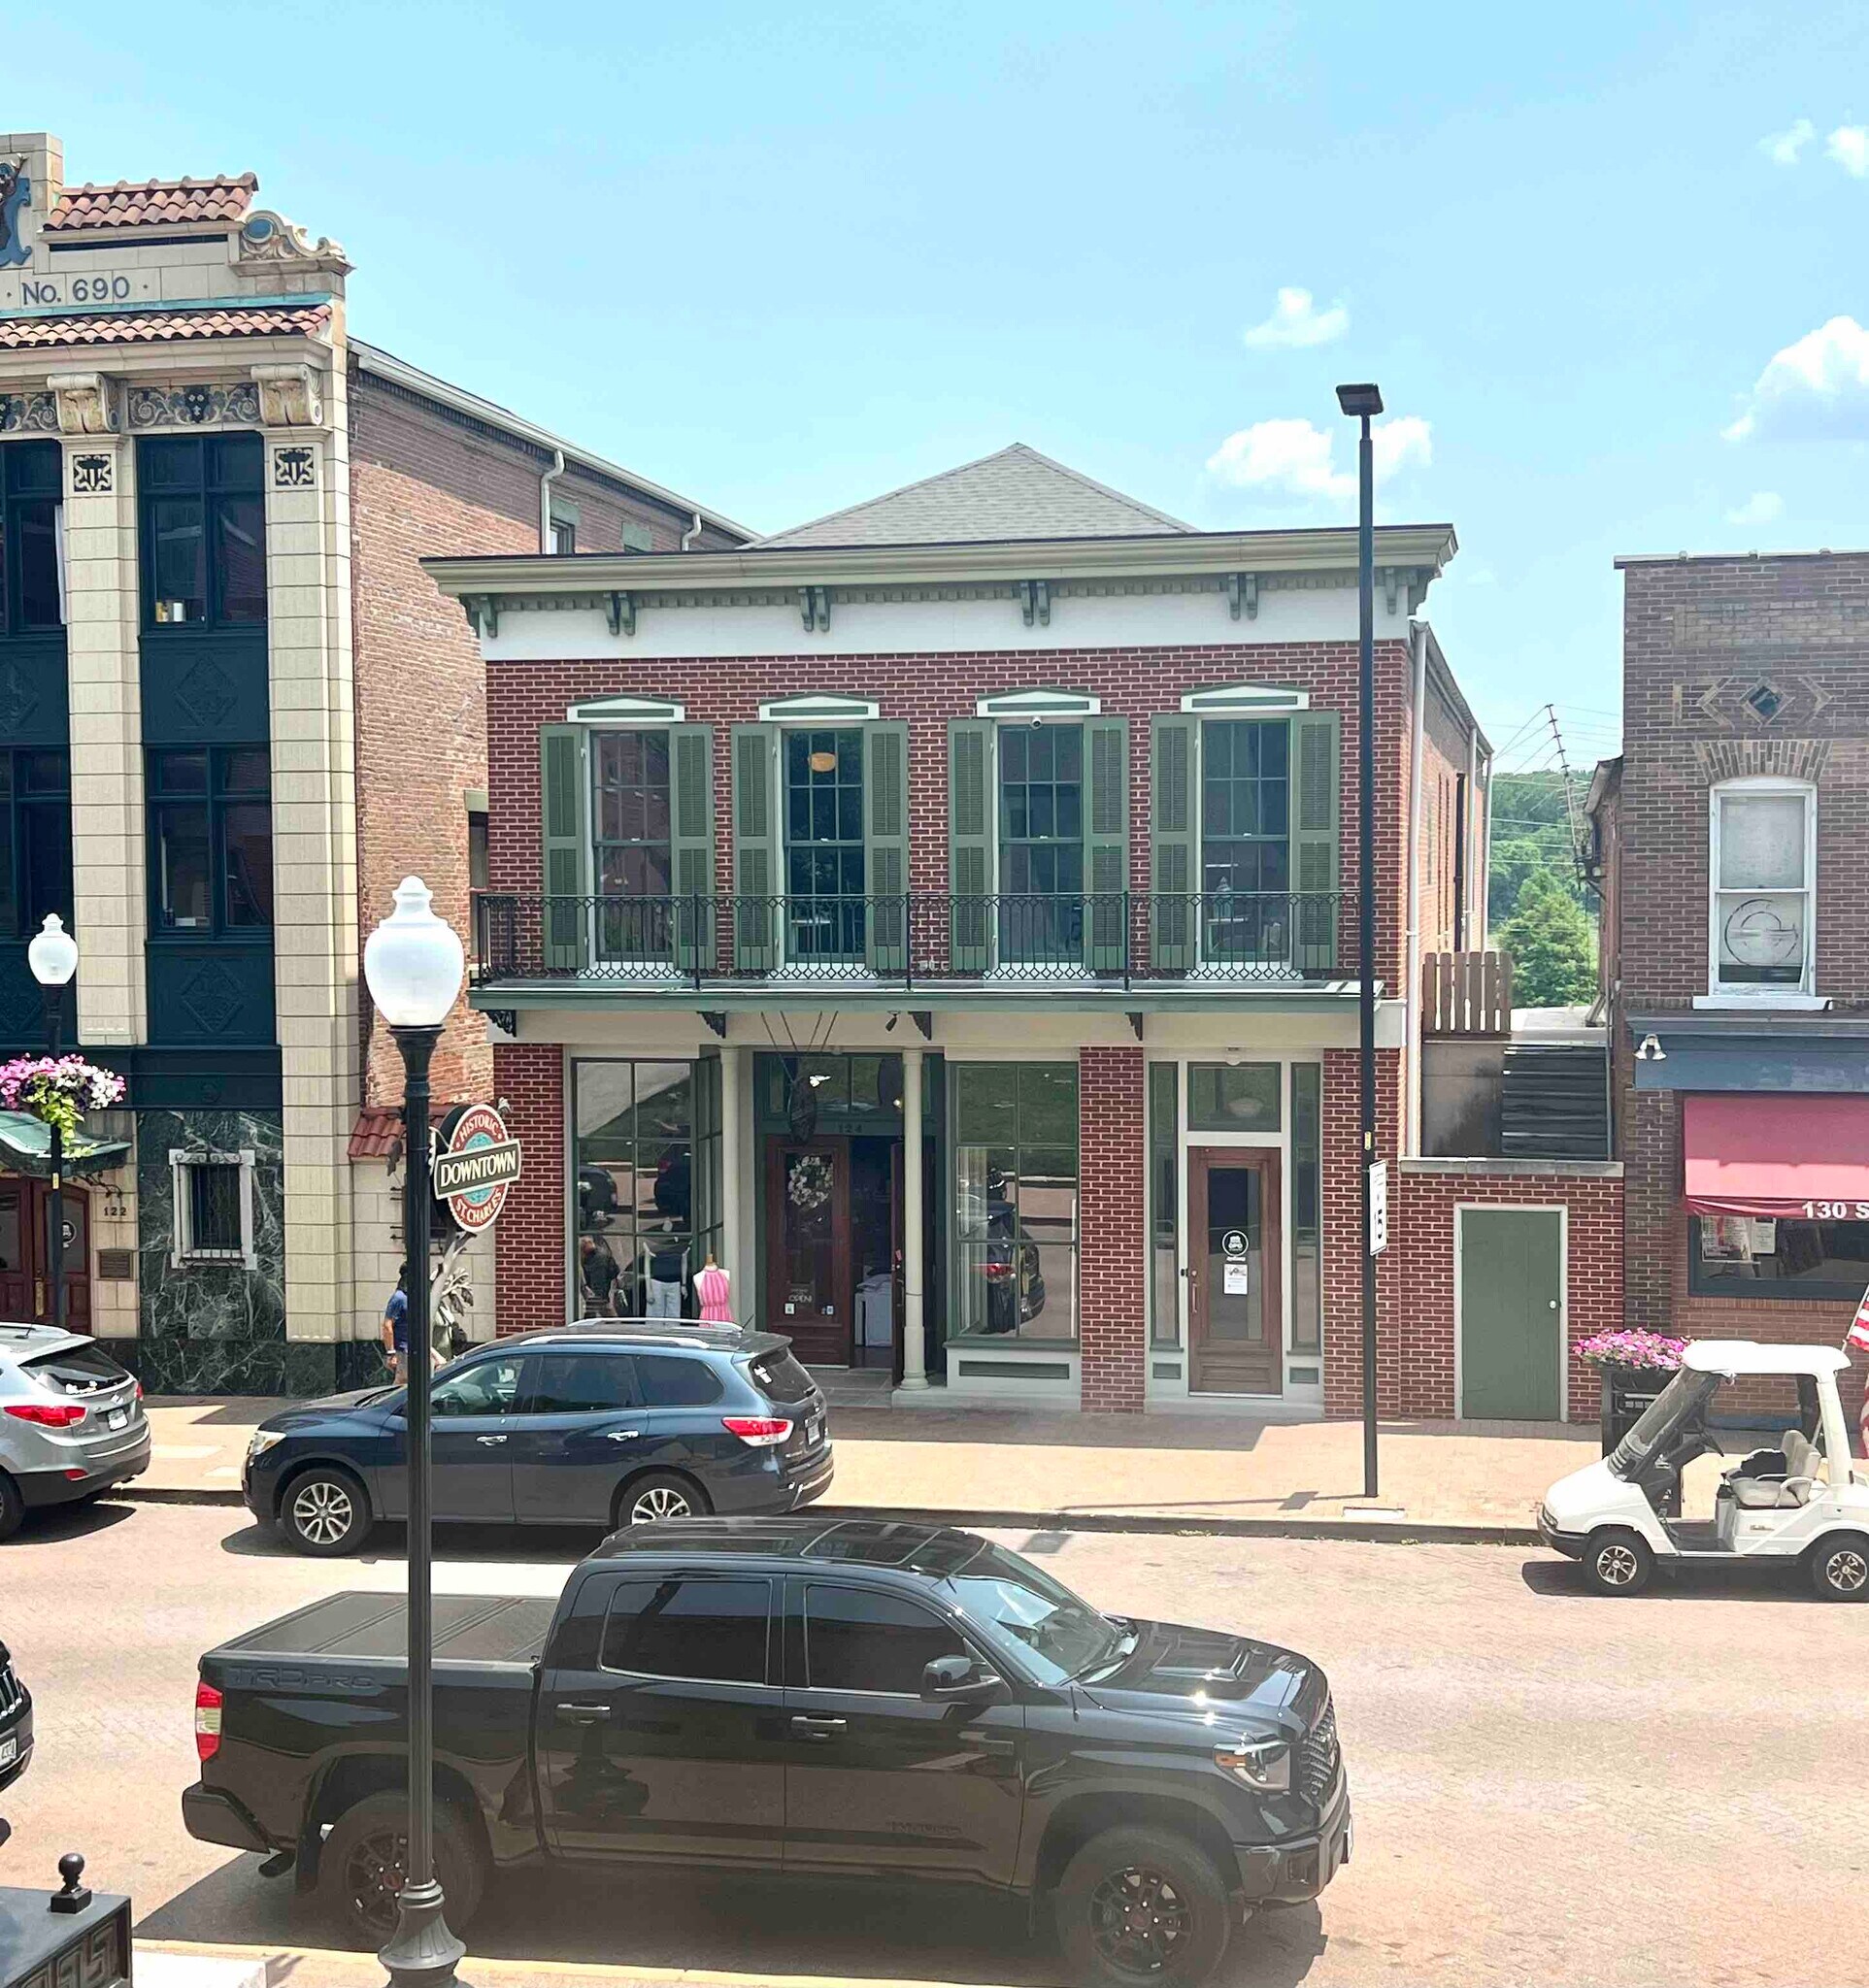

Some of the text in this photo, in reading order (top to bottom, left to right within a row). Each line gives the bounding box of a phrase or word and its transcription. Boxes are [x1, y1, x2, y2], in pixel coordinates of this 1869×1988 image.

[21, 276, 130, 305] No. 690
[458, 1114, 499, 1142] HISTORIC
[440, 1150, 516, 1187] DOWNTOWN
[104, 1207, 127, 1216] 122
[467, 1190, 502, 1223] CHARLES
[1802, 1201, 1848, 1219] 130
[228, 1666, 304, 1688] TRD
